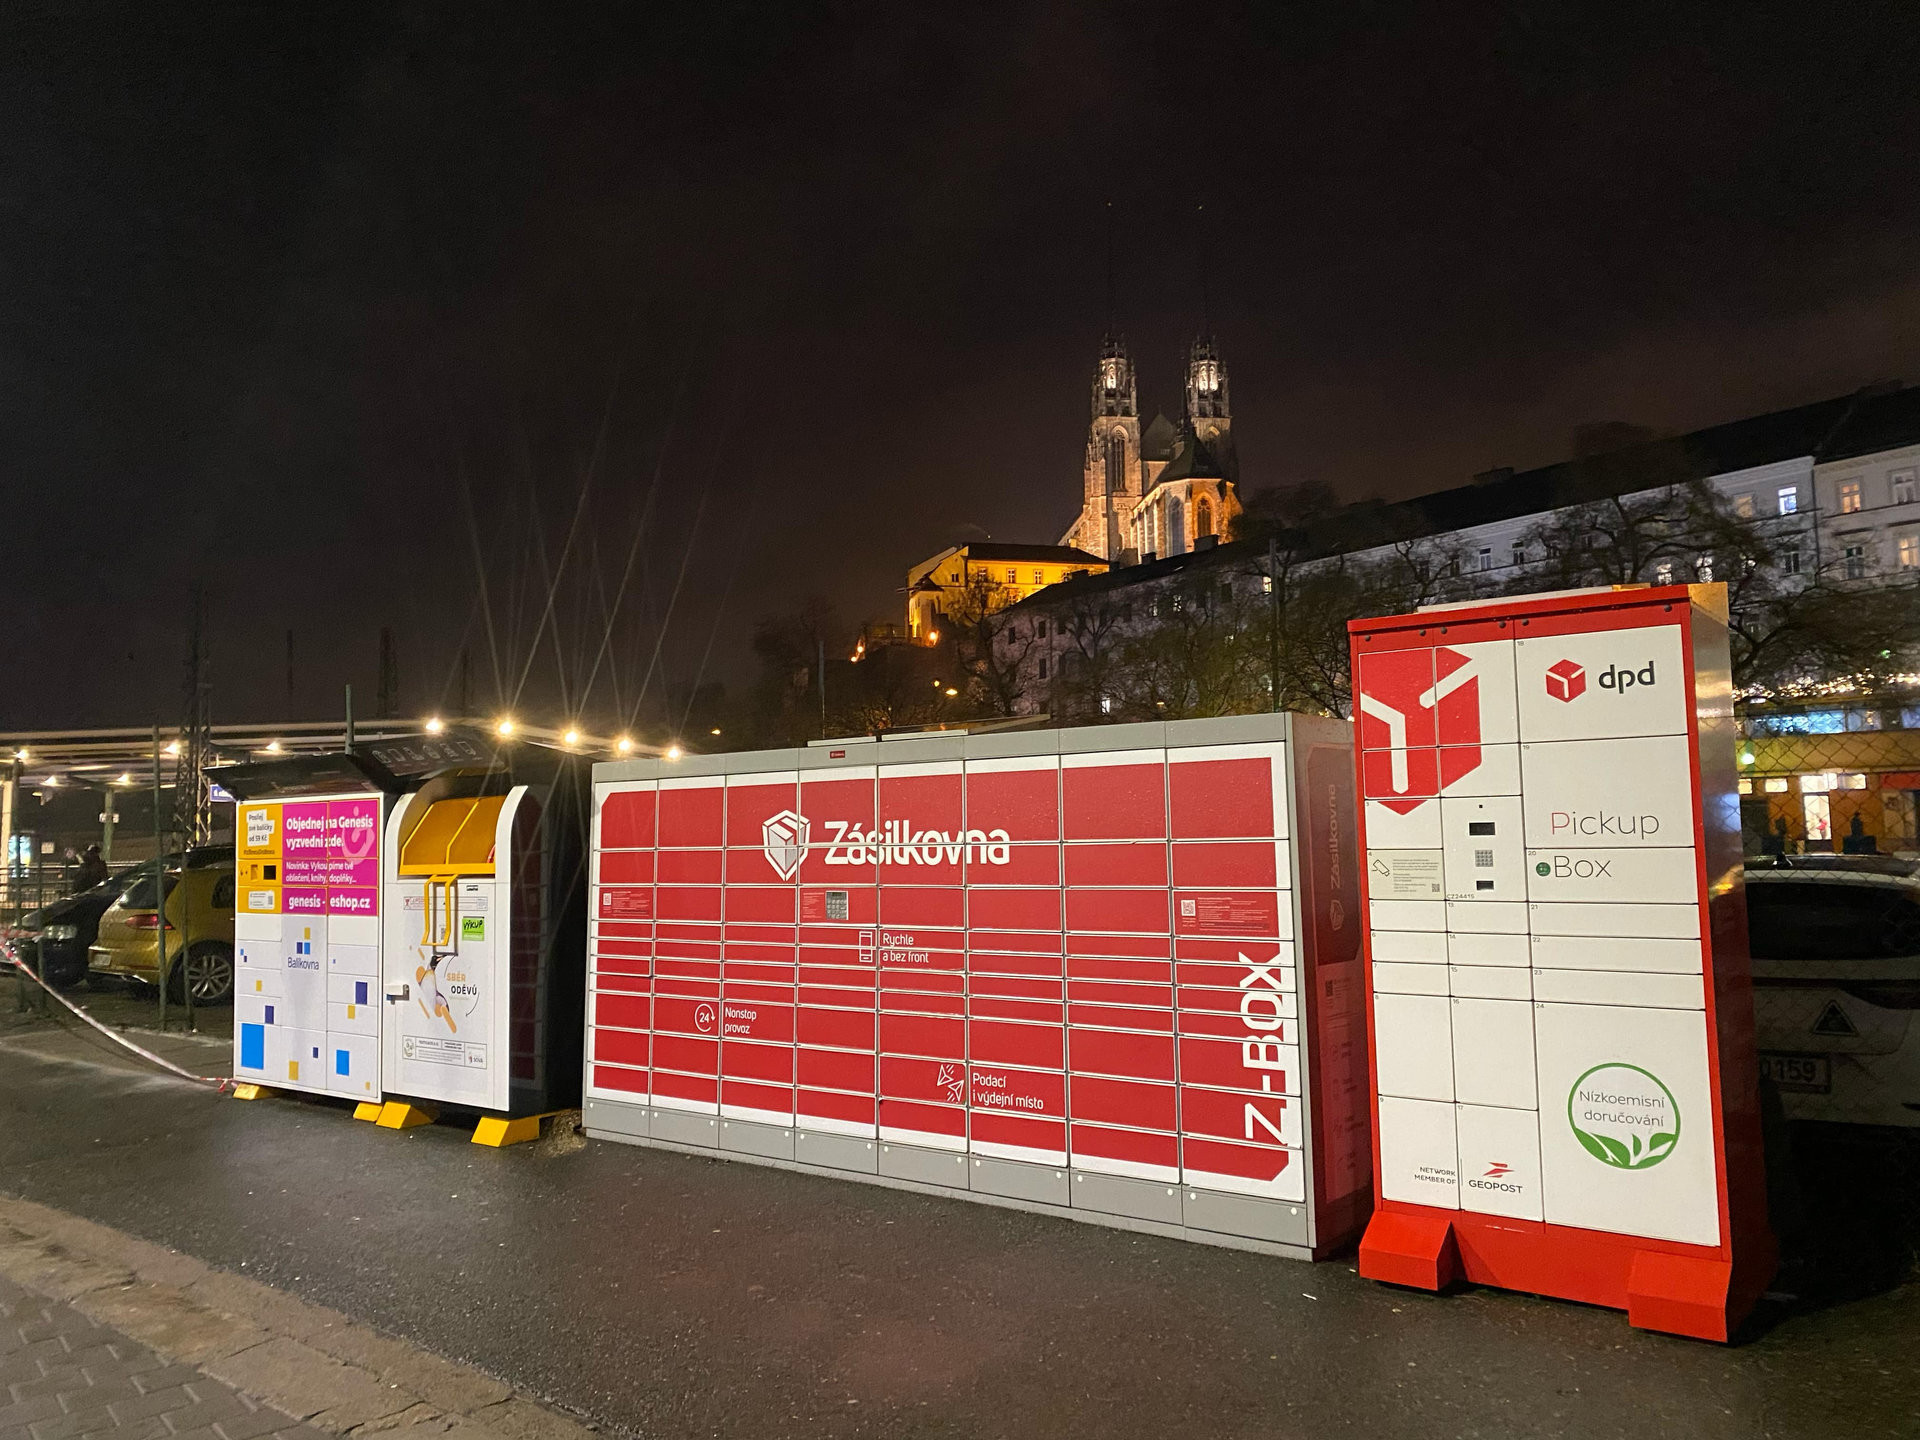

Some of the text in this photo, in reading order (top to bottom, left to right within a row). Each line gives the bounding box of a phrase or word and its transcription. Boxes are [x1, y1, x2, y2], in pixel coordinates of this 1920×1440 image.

[1599, 661, 1655, 694] dpd
[286, 814, 373, 832] Objednej na Genesis
[1551, 811, 1660, 840] Pickup
[286, 835, 323, 850] vyzvedni
[824, 819, 1010, 866] Zásilkovna
[1554, 855, 1612, 878] Box
[288, 894, 321, 909] genesis
[330, 894, 371, 911] eshop.cz
[882, 933, 914, 948] Rychle
[882, 951, 929, 963] a bez front
[700, 1012, 709, 1023] 24
[724, 1007, 757, 1021] Nonstop
[724, 1023, 750, 1034] provoz
[1238, 951, 1289, 1145] Z-BOX
[972, 1072, 1007, 1088] Podací
[977, 1090, 1014, 1107] výdejní
[1015, 1095, 1044, 1110] místo
[1579, 1090, 1665, 1108] Nízkoemisní
[1584, 1110, 1664, 1127] doručování
[1414, 1174, 1446, 1184] MEMBER
[1419, 1166, 1456, 1176] NETWORK
[1468, 1180, 1523, 1194] GEOPOST
